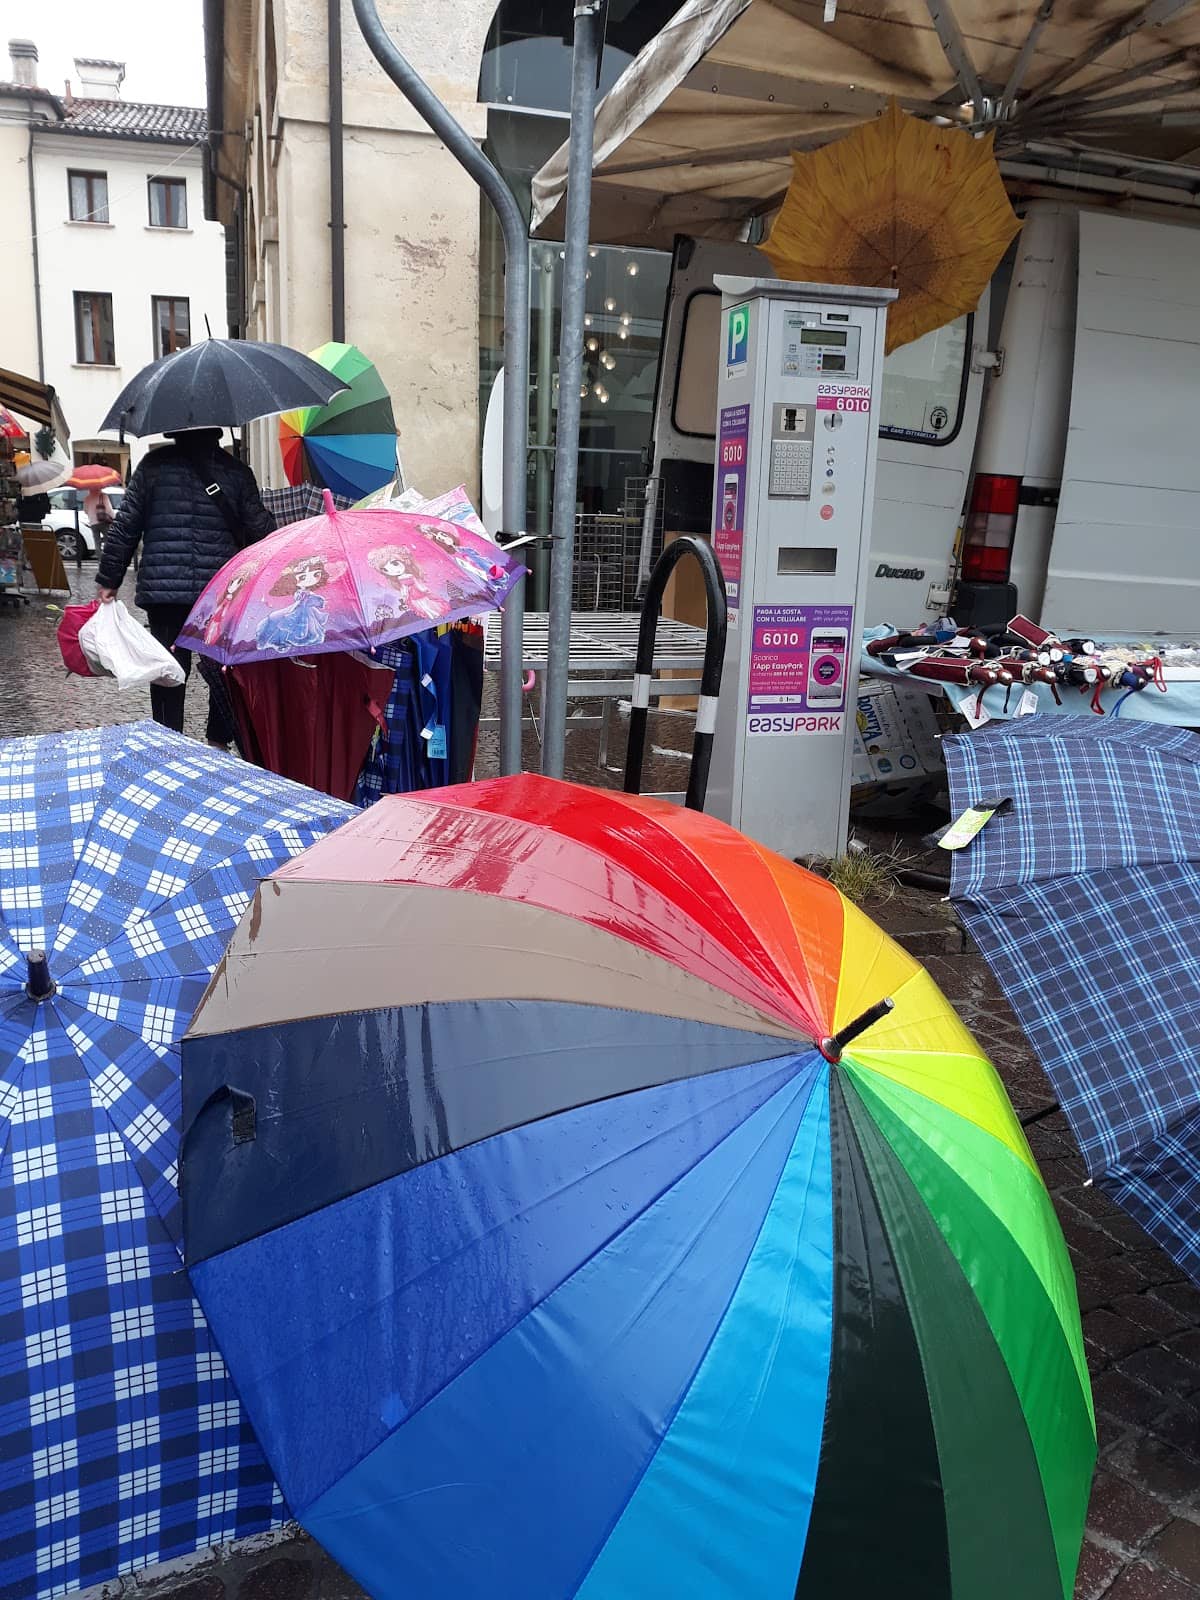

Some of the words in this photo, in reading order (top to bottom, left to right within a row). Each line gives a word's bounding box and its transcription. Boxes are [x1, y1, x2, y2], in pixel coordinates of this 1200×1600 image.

[731, 313, 746, 360] P
[836, 398, 870, 411] 6010
[723, 444, 742, 462] 6010
[875, 564, 925, 581] Ducato
[762, 633, 799, 646] 6010
[772, 662, 804, 671] EasyPark
